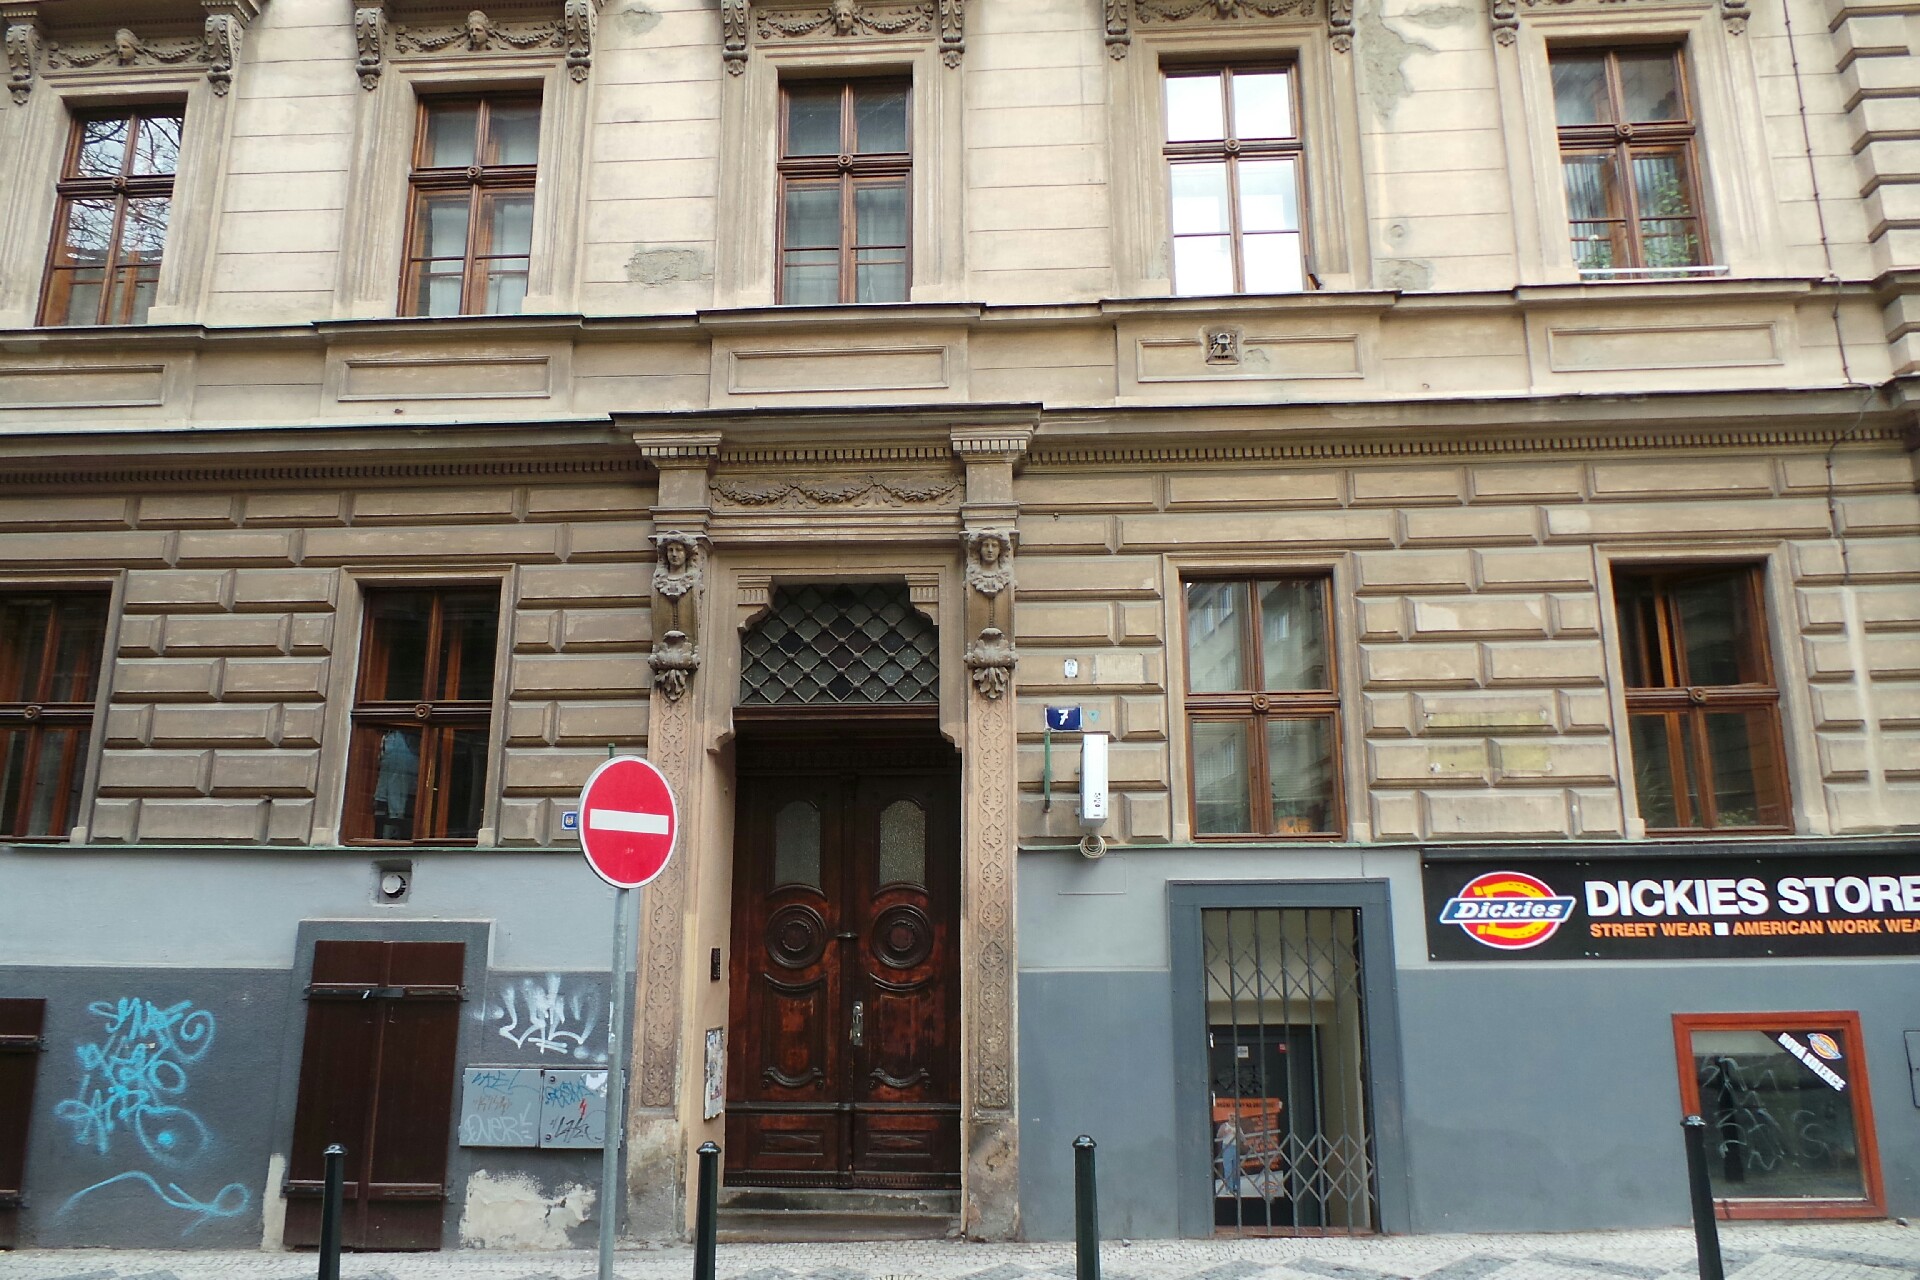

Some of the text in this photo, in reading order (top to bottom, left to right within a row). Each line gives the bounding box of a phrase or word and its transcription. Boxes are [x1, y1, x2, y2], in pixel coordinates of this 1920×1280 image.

[1058, 709, 1069, 726] 7
[1584, 875, 1920, 917] DICKIES STORE
[1453, 901, 1563, 918] Dickies
[1590, 922, 1657, 938] STREET
[1661, 921, 1711, 937] WEAR
[1732, 920, 1824, 936] AMERICAN
[1826, 919, 1882, 934] WORK
[1778, 1032, 1808, 1060] NOVÁ
[1802, 1052, 1846, 1091] KOLEKCE
